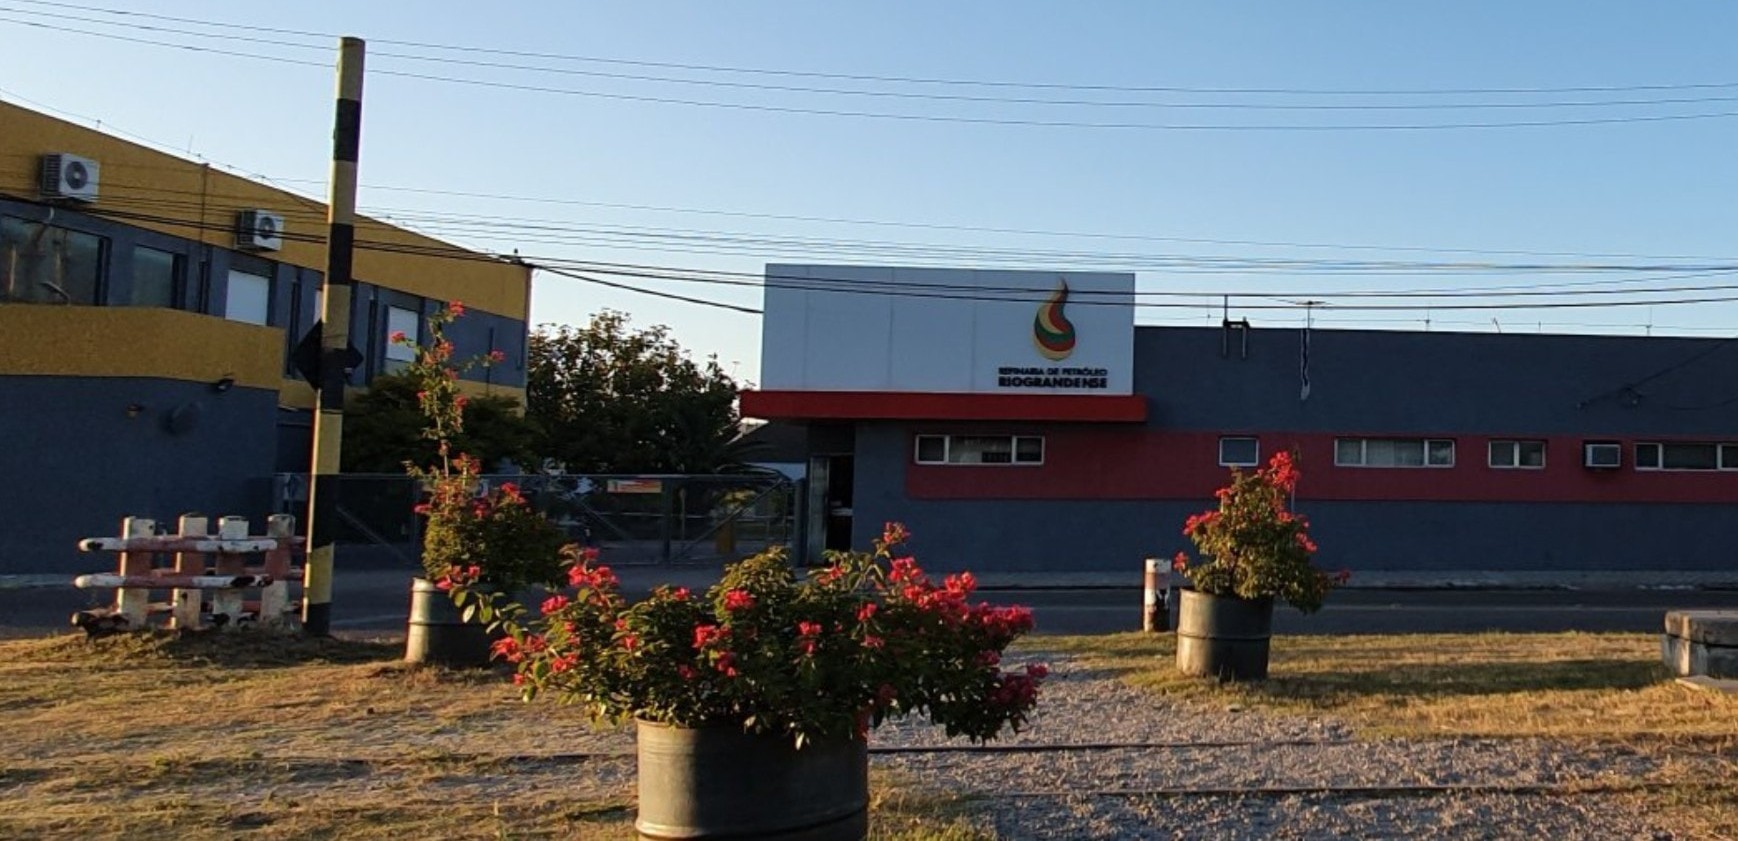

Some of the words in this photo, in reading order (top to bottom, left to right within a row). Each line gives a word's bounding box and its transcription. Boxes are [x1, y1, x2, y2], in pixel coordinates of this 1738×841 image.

[998, 367, 1044, 375] REFINARIA
[1047, 367, 1059, 375] DE
[998, 377, 1108, 388] RIOGRANDENSE
